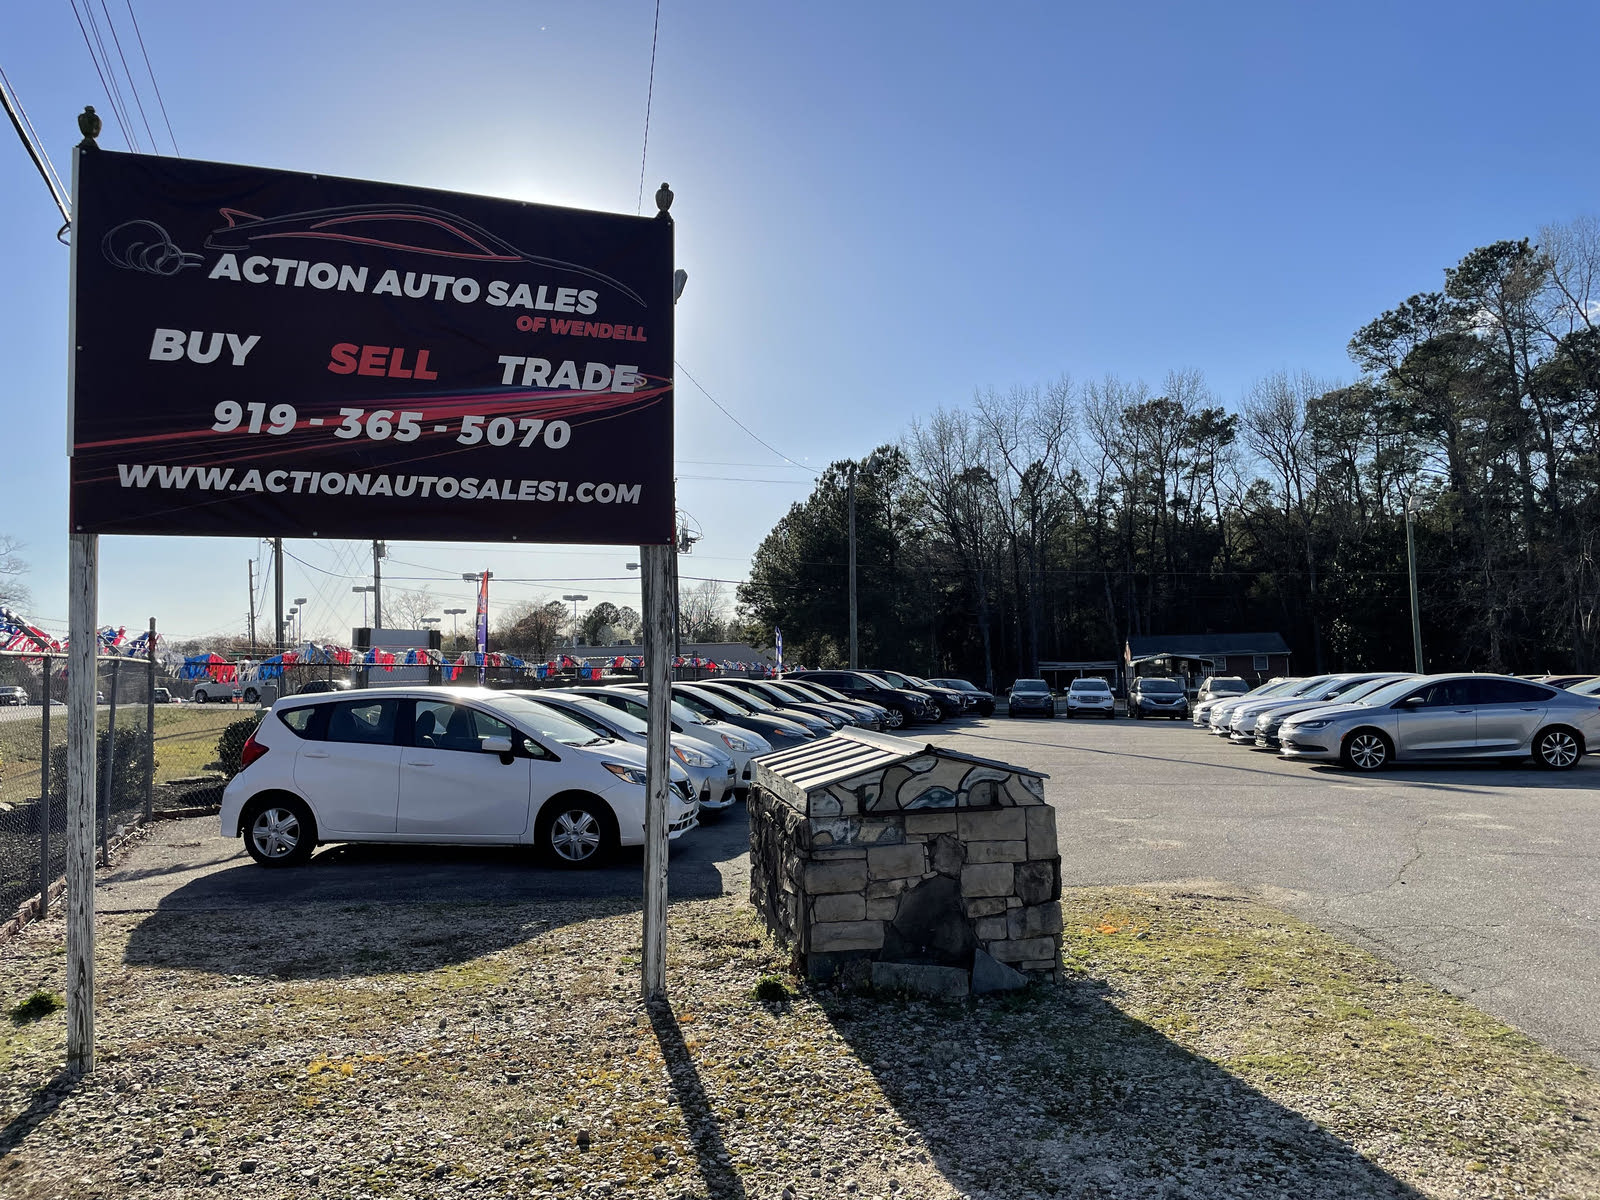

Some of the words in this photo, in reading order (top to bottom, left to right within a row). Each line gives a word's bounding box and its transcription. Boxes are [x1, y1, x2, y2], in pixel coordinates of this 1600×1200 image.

[208, 253, 369, 293] ACTION
[372, 269, 481, 303] AUTO
[485, 280, 599, 315] SALES
[149, 328, 261, 366] BUY
[516, 315, 547, 334] OF
[550, 319, 648, 342] WENDELL
[327, 343, 438, 381] SELL
[498, 355, 639, 394] TRADE
[211, 400, 298, 435] 919
[333, 407, 424, 442] 365
[456, 415, 572, 450] 5070
[117, 464, 642, 505] WWW.ACTIONAUTOSALES1.COM
